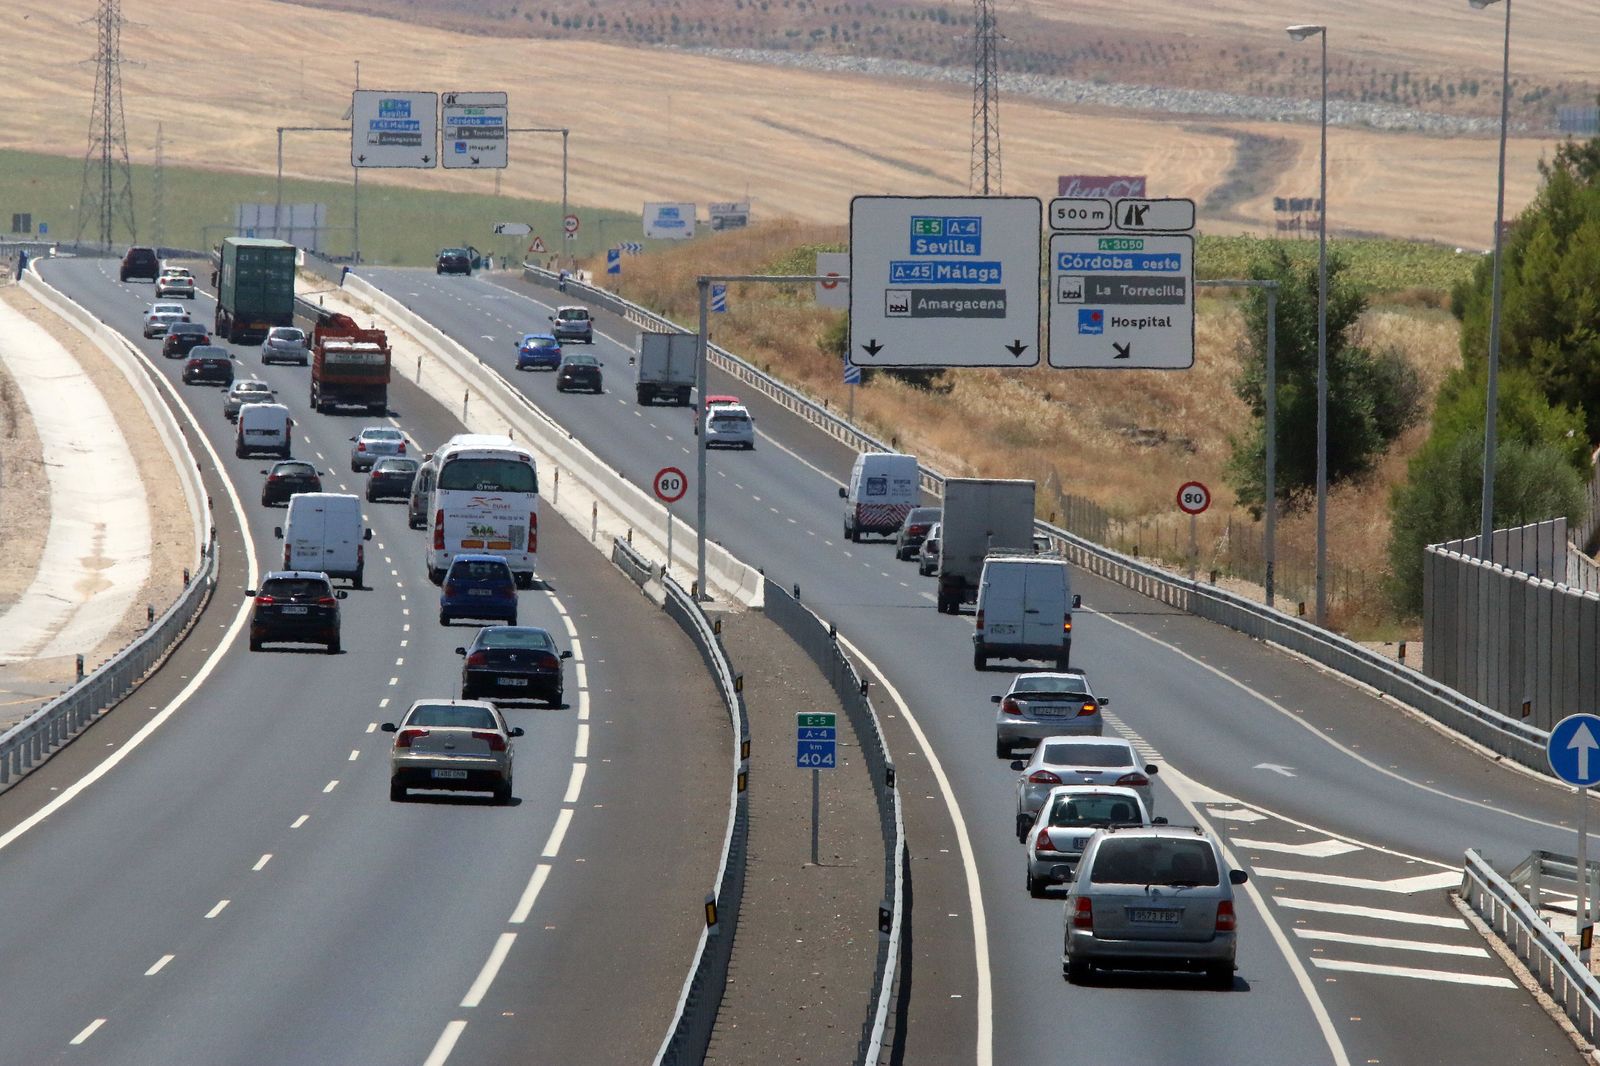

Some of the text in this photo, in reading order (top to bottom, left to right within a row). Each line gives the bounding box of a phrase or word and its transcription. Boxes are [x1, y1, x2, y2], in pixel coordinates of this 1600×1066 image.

[1057, 208, 1104, 219] 500 m
[915, 221, 977, 232] E-5 A-4
[916, 239, 976, 254] Sevilla
[1100, 240, 1144, 249] A-3050
[1060, 254, 1179, 270] Córdoba oeste
[895, 264, 999, 282] A-45 Málaga
[1096, 284, 1184, 296] La Torrecilla
[917, 298, 1005, 312] Amargacena
[1111, 316, 1172, 330] Hospital
[661, 478, 680, 490] 80
[1184, 493, 1203, 504] 80
[807, 716, 826, 725] E-5
[805, 730, 828, 738] A-4
[798, 752, 834, 766] 404
